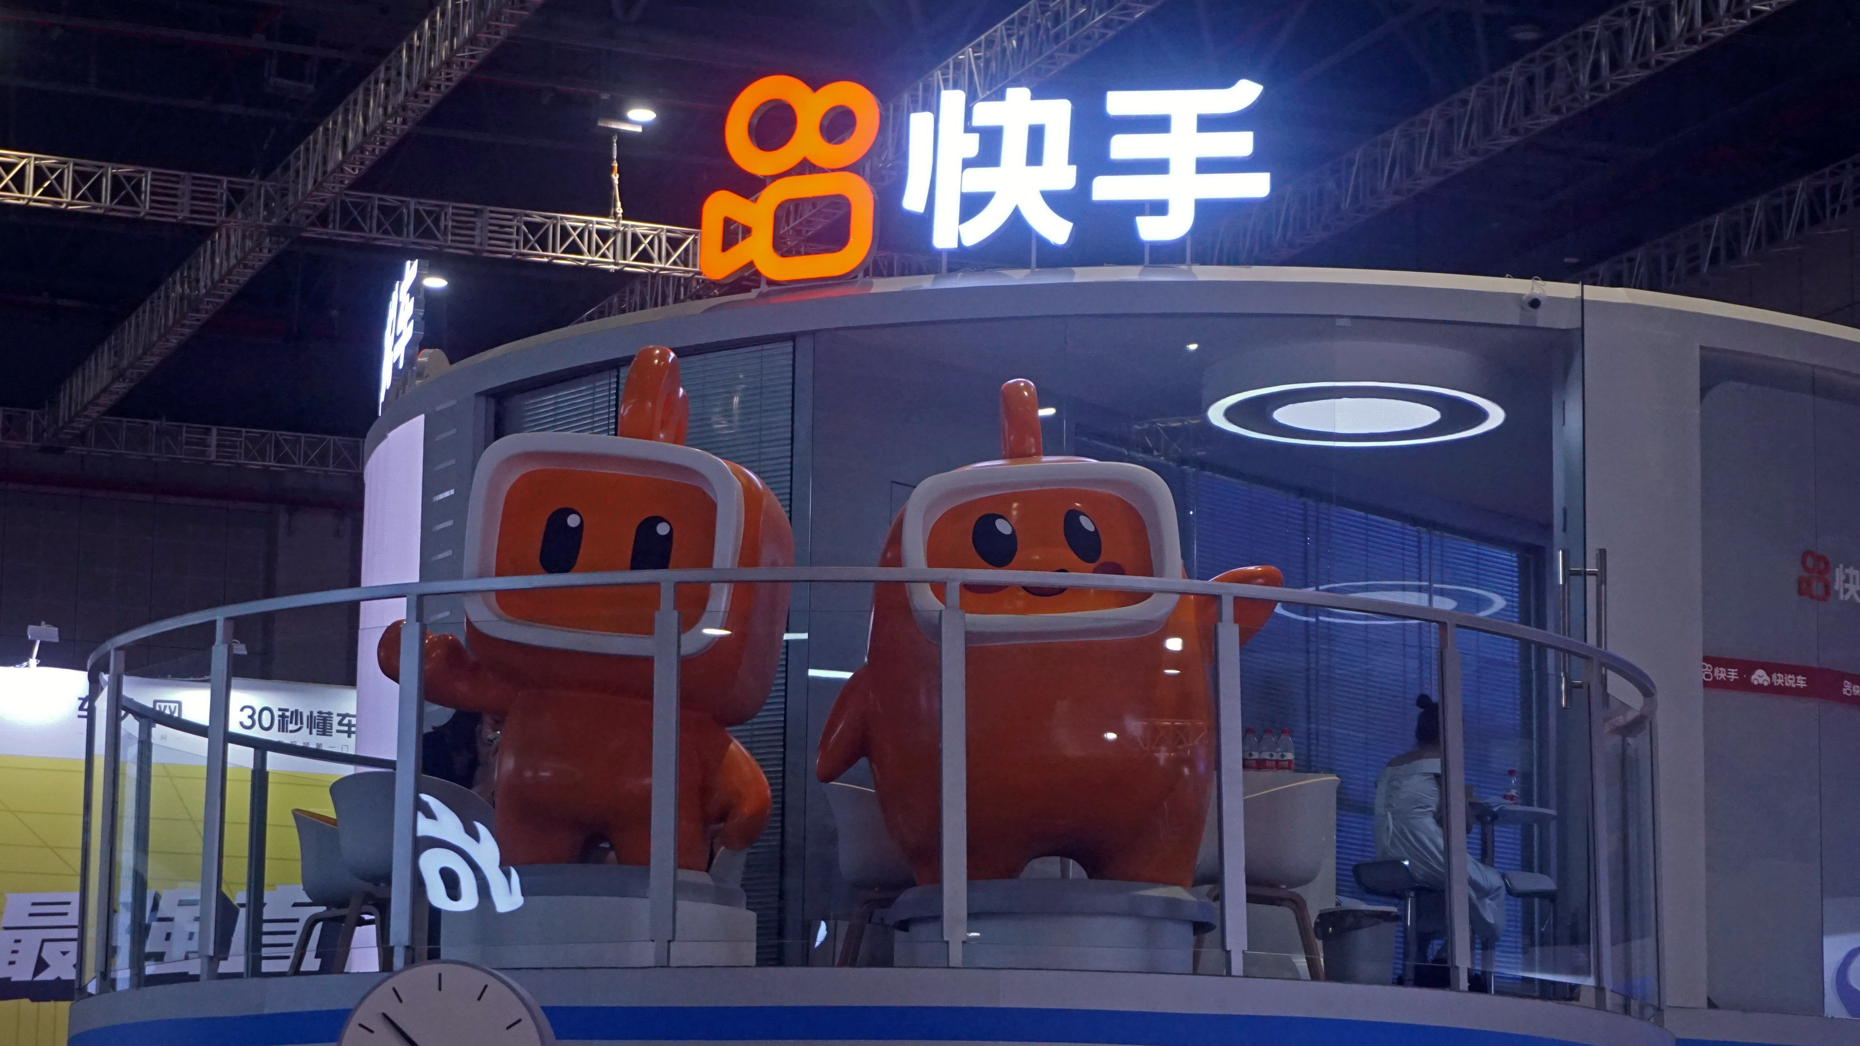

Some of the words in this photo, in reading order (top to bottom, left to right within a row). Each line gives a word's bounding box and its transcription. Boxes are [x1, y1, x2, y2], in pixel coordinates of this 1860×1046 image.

[902, 79, 1271, 249] 快手
[1714, 667, 1739, 682] 快手
[1772, 672, 1808, 689] 快说车
[239, 705, 356, 738] 30秒懂车
